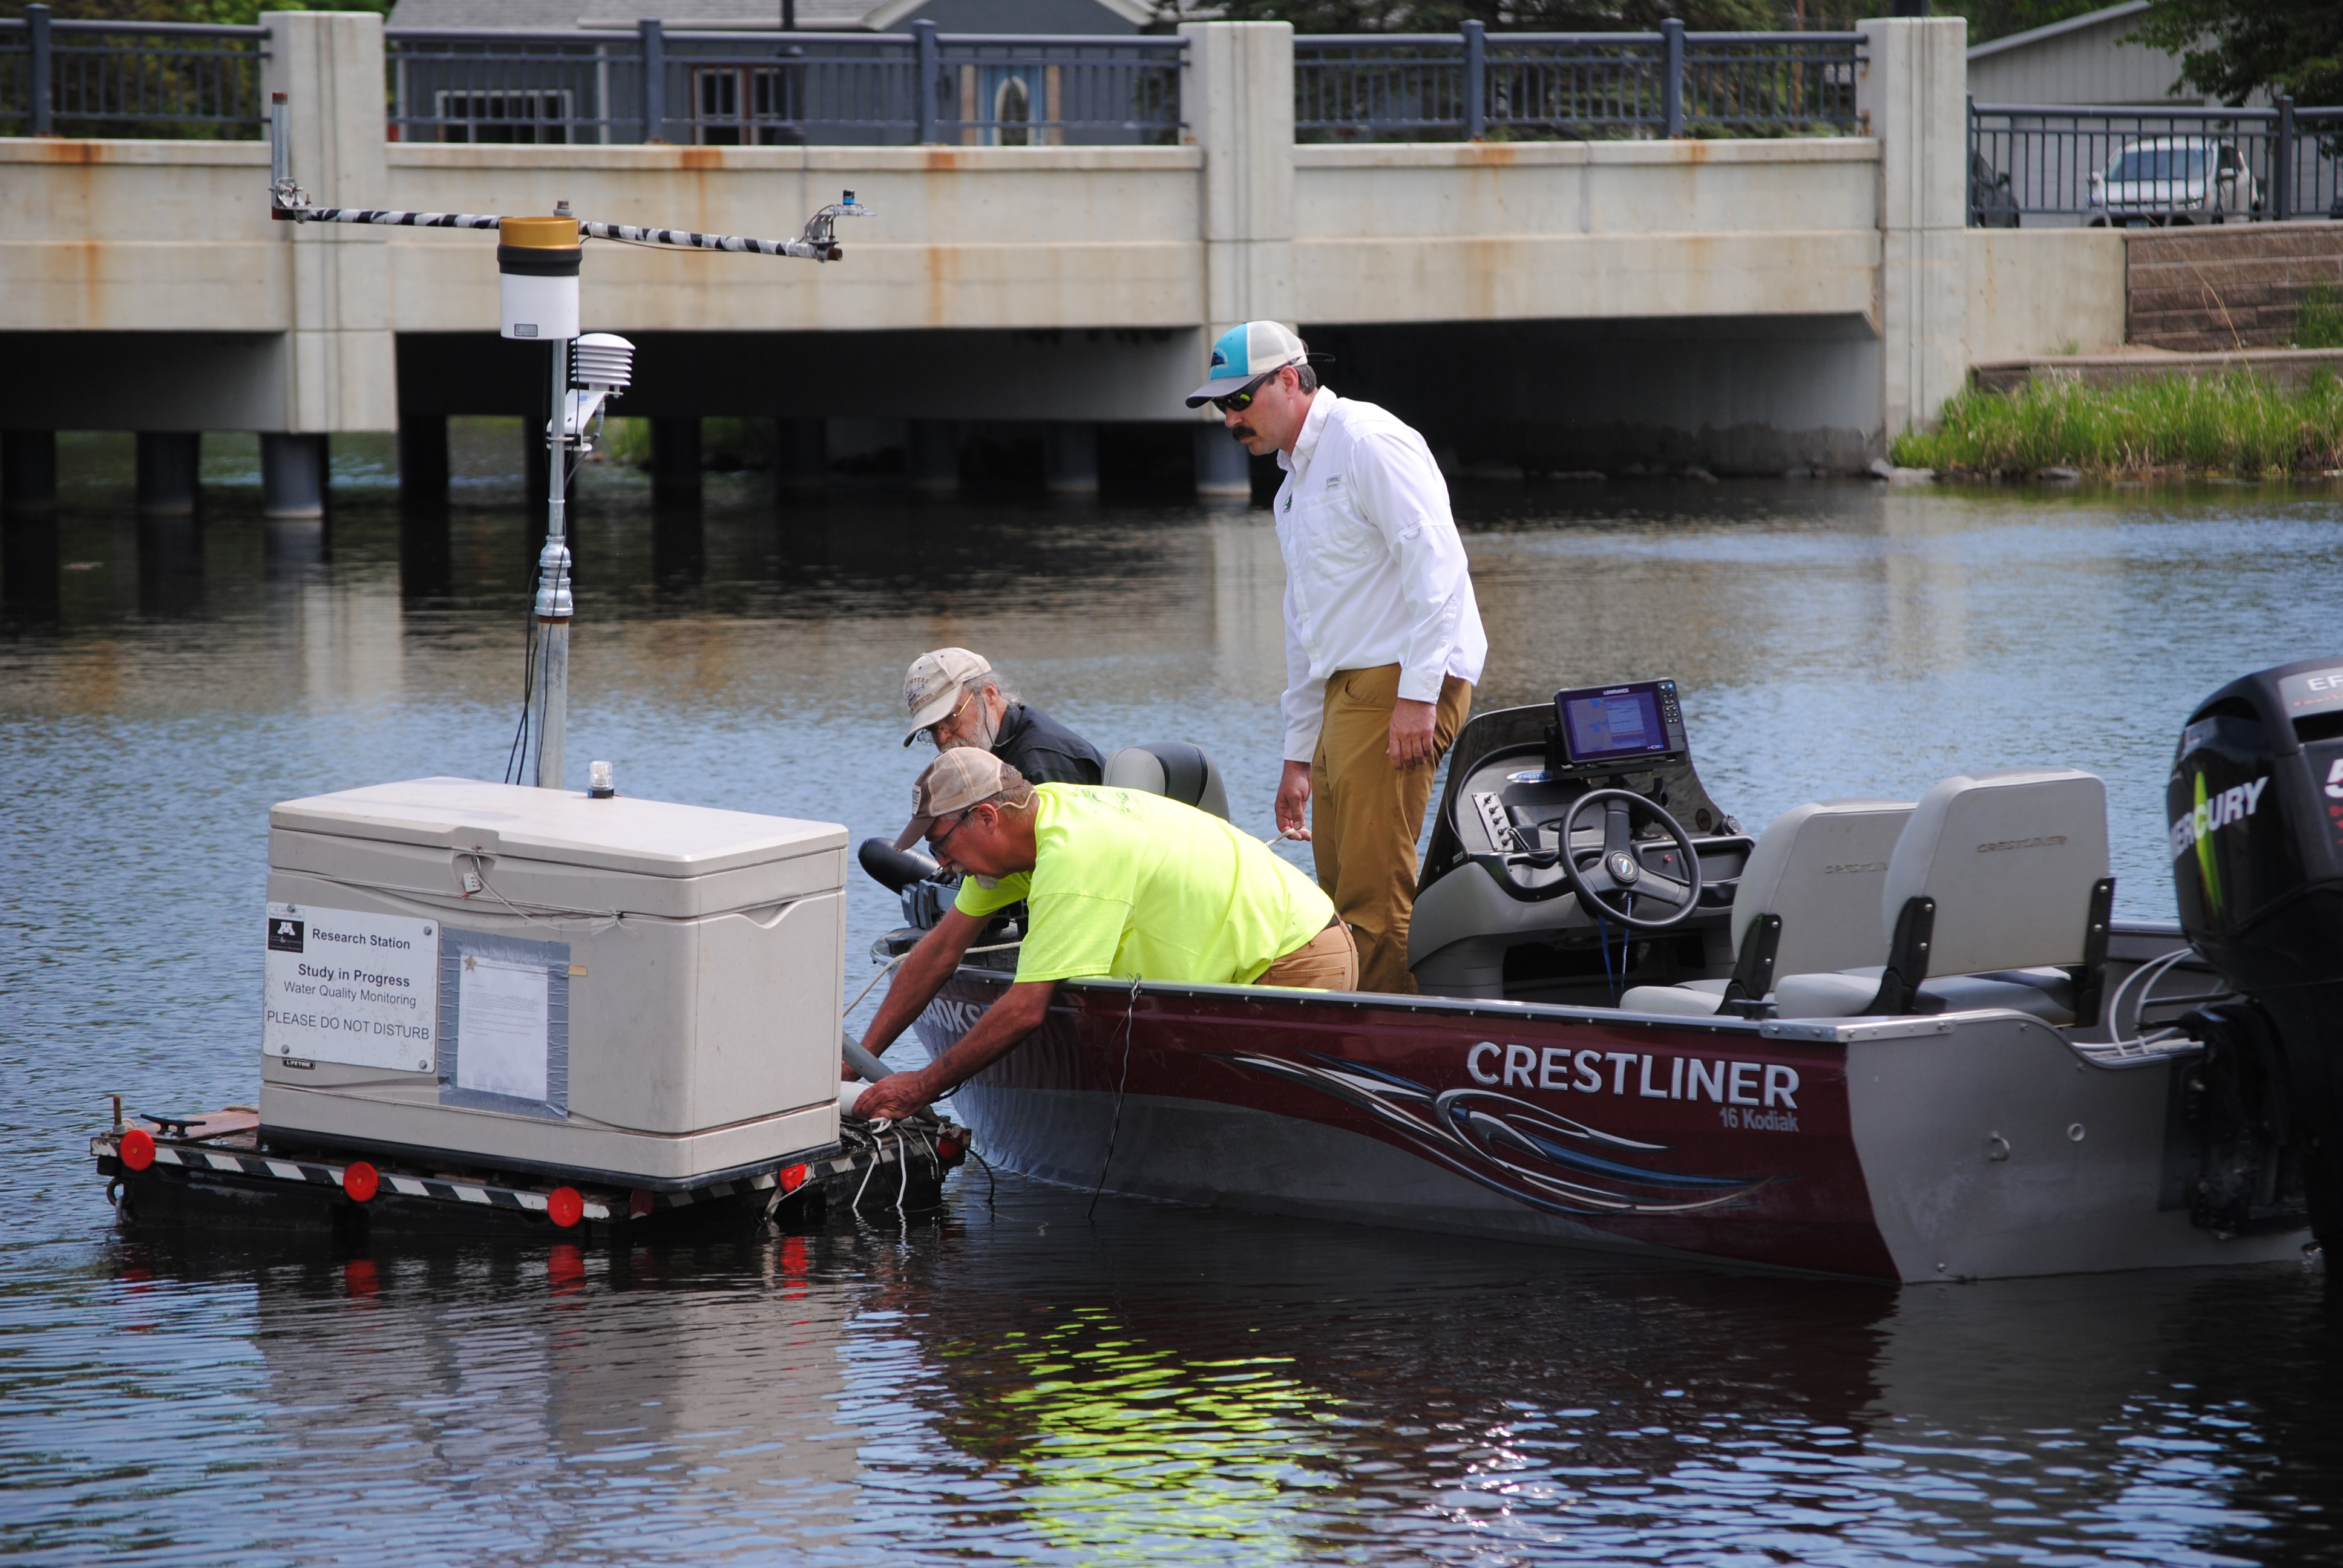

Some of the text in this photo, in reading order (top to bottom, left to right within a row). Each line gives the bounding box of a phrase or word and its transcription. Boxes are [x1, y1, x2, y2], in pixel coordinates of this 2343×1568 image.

[312, 928, 410, 950] Research Station
[298, 964, 410, 987] Study in Progress
[284, 981, 416, 1009] Water Quality Monitoring
[267, 1010, 430, 1040] PLEASE DO NOT DISTURB
[1467, 1041, 1800, 1110] CRESTLINER
[1719, 1106, 1800, 1132] 16 Kodiak
